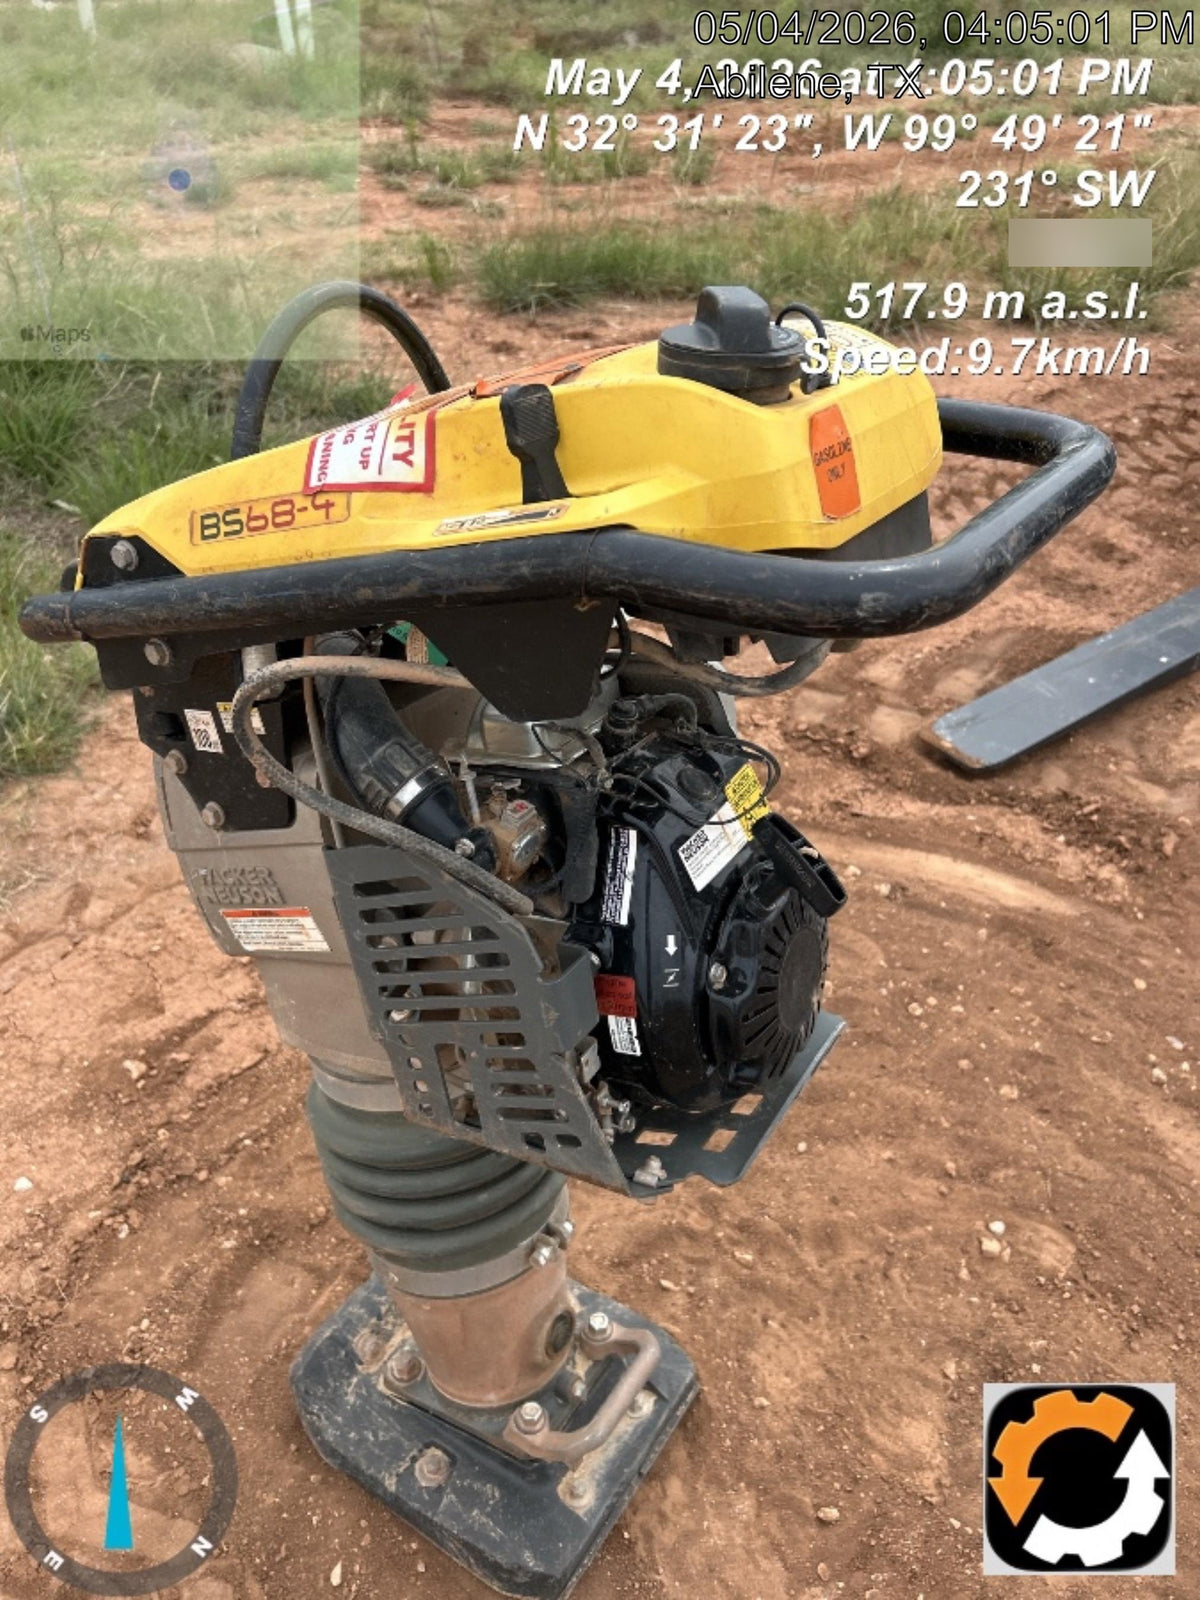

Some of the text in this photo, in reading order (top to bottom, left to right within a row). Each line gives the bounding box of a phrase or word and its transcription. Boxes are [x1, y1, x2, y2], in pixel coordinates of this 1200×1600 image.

[358, 446, 373, 470] UP
[393, 415, 417, 468] ITY
[200, 493, 335, 541] BS68-4
